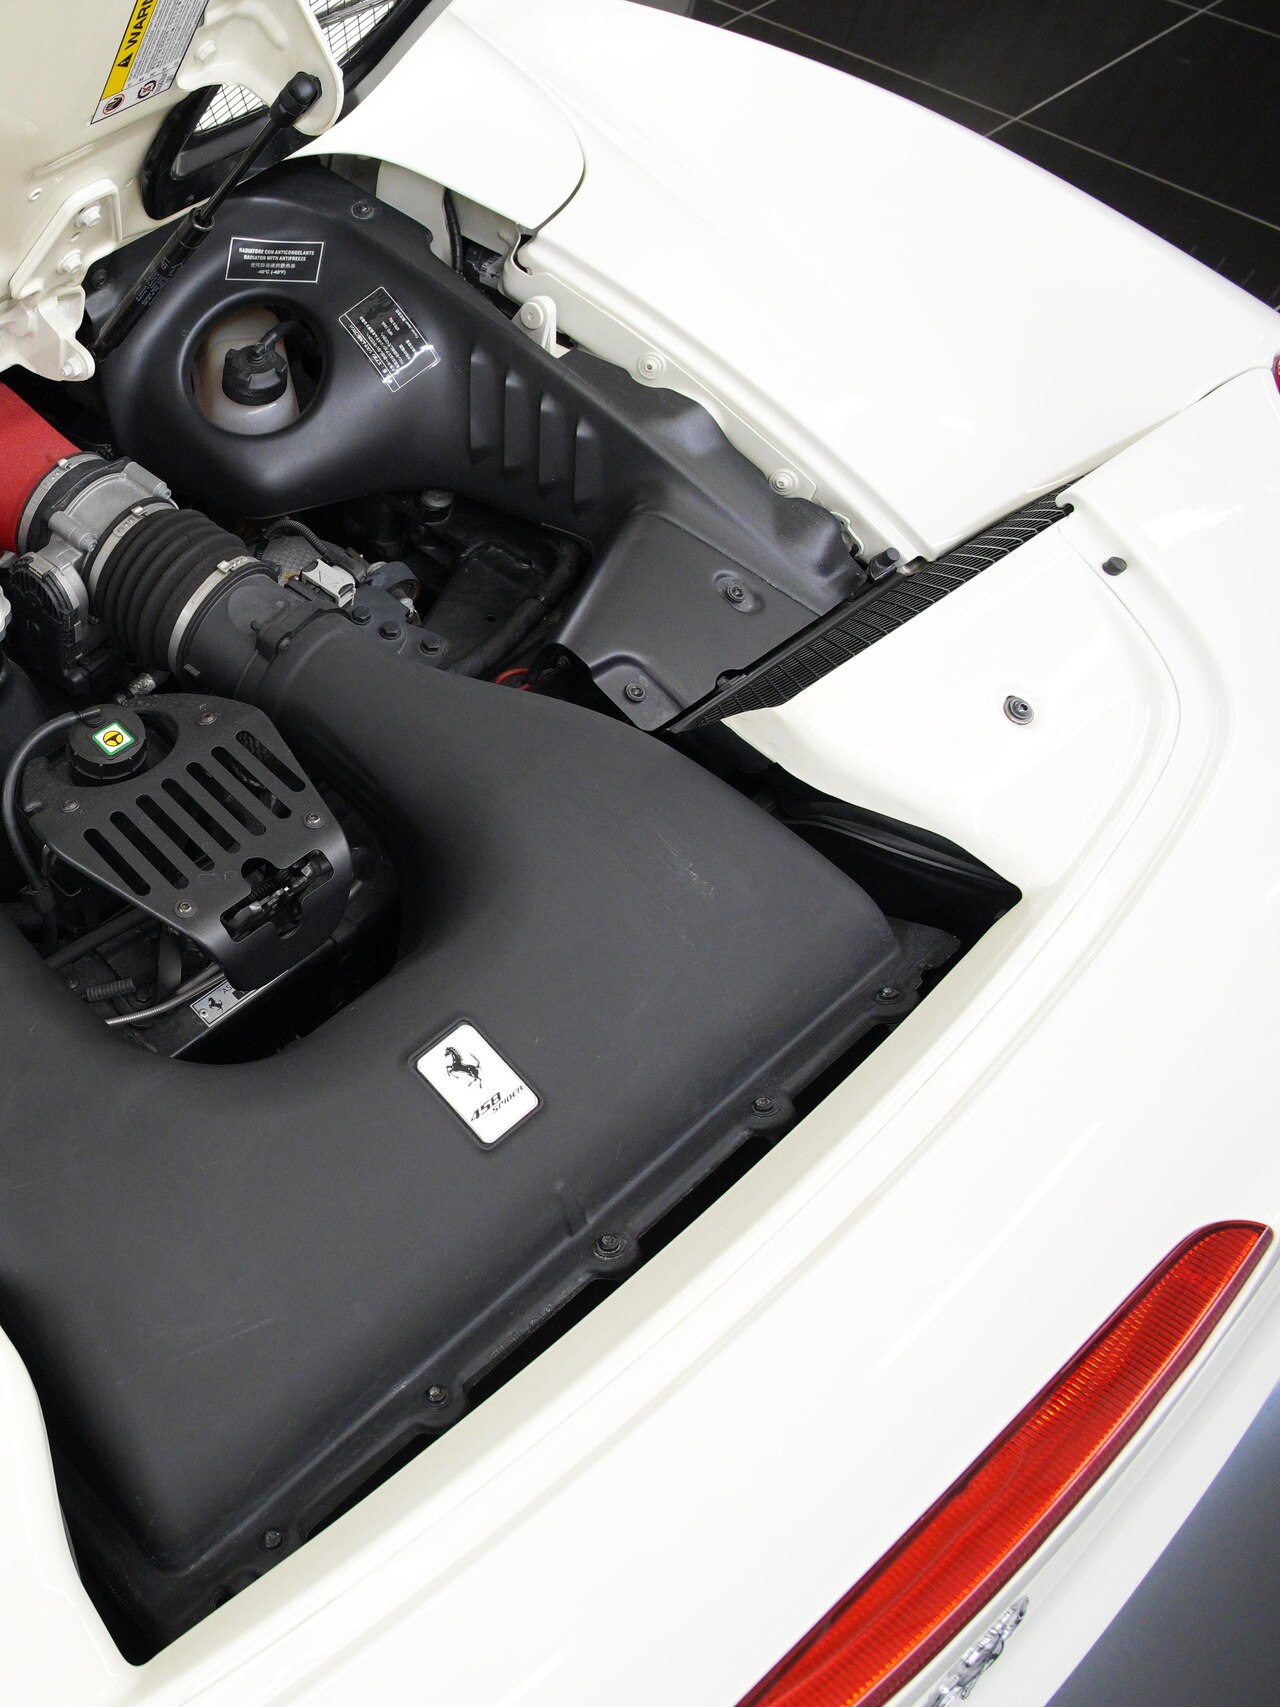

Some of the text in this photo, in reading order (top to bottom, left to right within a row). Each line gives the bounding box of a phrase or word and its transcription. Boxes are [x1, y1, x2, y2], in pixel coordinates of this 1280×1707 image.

[238, 247, 264, 255] RADIATORE
[470, 1091, 502, 1122] 458
[492, 1085, 524, 1114] SPIDER
